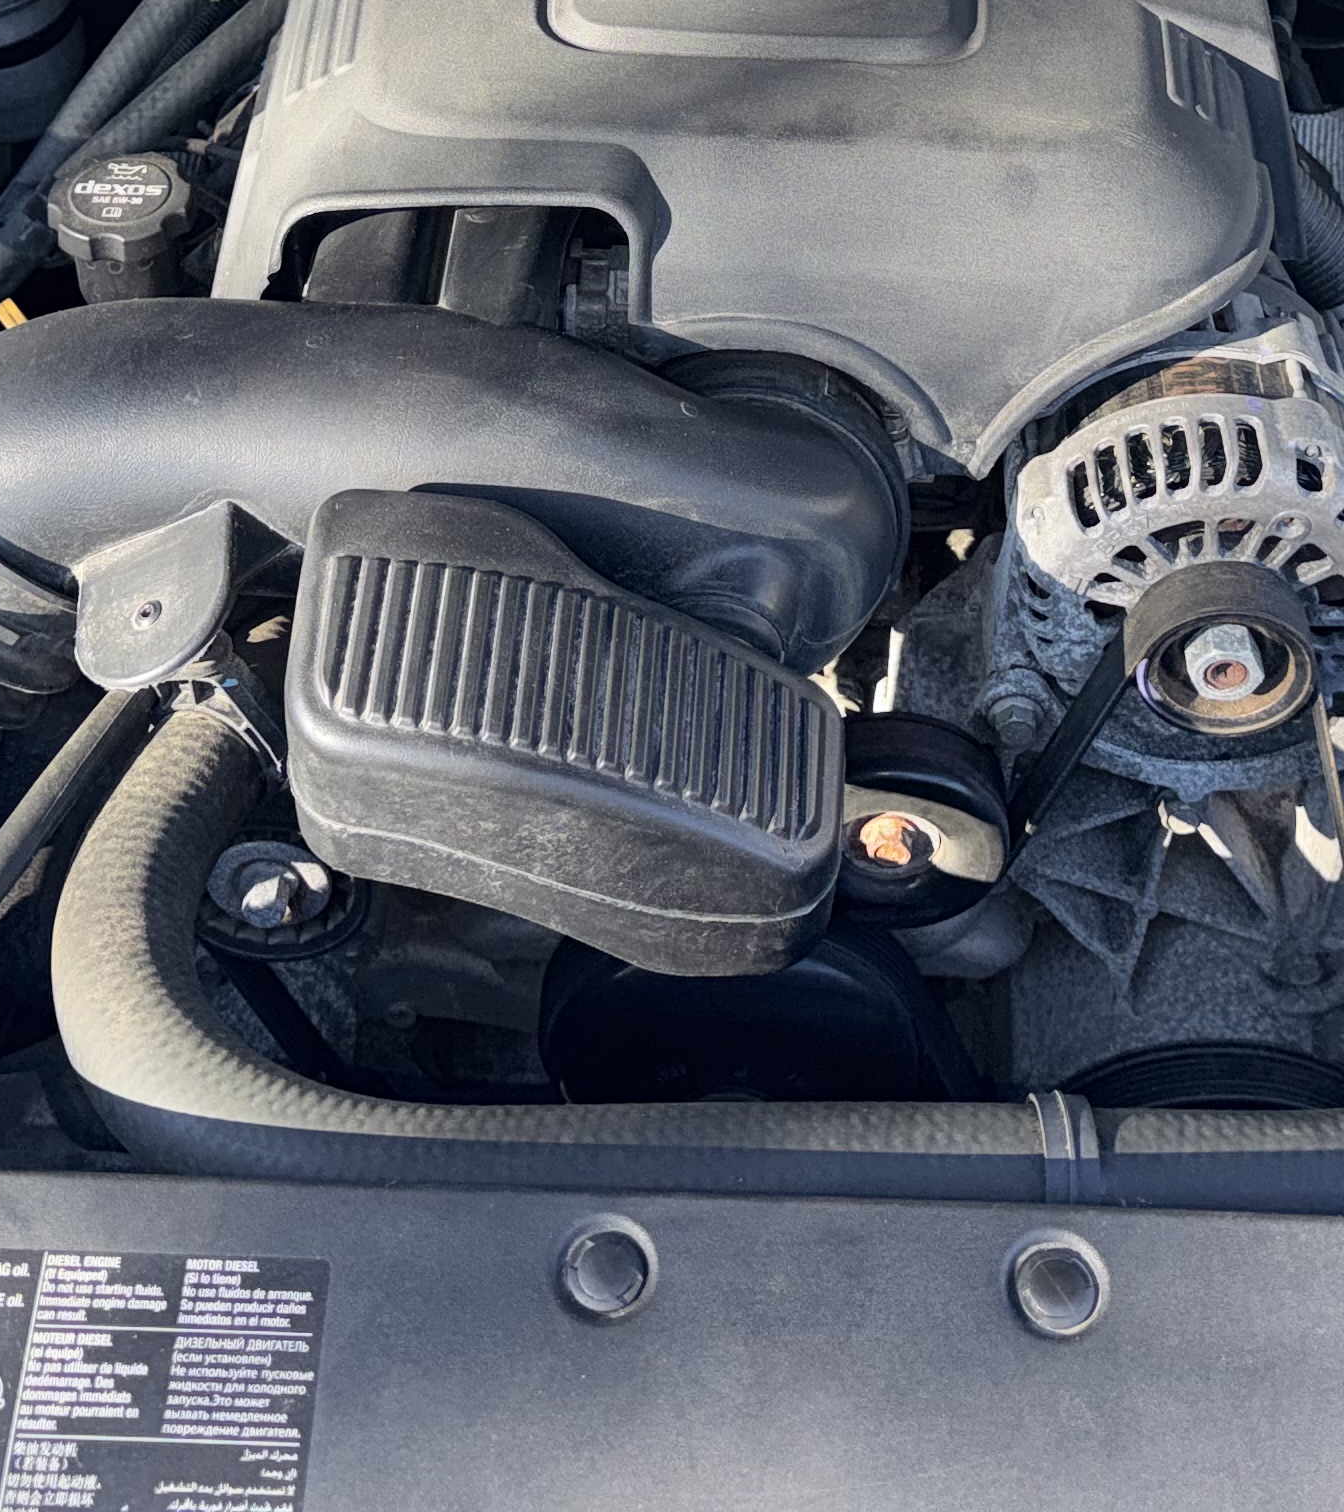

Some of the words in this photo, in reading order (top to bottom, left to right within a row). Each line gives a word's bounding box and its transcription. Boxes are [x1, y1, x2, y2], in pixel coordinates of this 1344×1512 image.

[74, 179, 168, 196] dexos
[92, 196, 111, 204] SAE
[112, 196, 143, 205] 5W-30
[47, 1254, 81, 1267] DIESEL
[83, 1255, 122, 1268] ENGINE
[185, 1259, 223, 1270] MOTOR
[224, 1260, 260, 1272] DIESEL
[12, 1263, 31, 1277] oil.
[57, 1269, 108, 1283] Equipped)
[184, 1272, 199, 1285] (Si
[200, 1273, 210, 1284] lo
[211, 1274, 241, 1286] tiene)
[42, 1281, 56, 1293] Do
[56, 1282, 74, 1294] not
[76, 1284, 93, 1294] use
[95, 1283, 133, 1298] starting
[135, 1284, 164, 1297] fluids.
[182, 1285, 196, 1297] No
[197, 1287, 216, 1298] use
[218, 1287, 251, 1299] fluidos
[252, 1288, 266, 1299] de
[267, 1290, 314, 1303] arranque.
[6, 1293, 25, 1307] oil.
[40, 1295, 91, 1308] Immediate
[92, 1297, 126, 1310] engine
[127, 1298, 168, 1312] damage
[180, 1298, 194, 1311] Se
[194, 1300, 232, 1313] pueden
[232, 1301, 275, 1314] producir
[276, 1302, 307, 1315] daños
[36, 1310, 55, 1320] can
[56, 1310, 87, 1322] result.
[233, 1316, 247, 1326] en
[248, 1315, 259, 1327] el
[260, 1316, 291, 1328] motor.
[32, 1331, 76, 1344] MOTEUR
[76, 1333, 113, 1347] DIESEL
[173, 1336, 245, 1350] ДИЗЕЛЬНЫЙ
[246, 1339, 310, 1353] ДВИГАТЕЛЬ
[172, 1350, 202, 1363] (если
[204, 1353, 272, 1367] установлен)
[27, 1359, 42, 1373] Ne
[42, 1362, 62, 1375] pas
[63, 1361, 99, 1374] utiliser
[99, 1362, 113, 1374] de
[113, 1362, 149, 1377] liquide
[169, 1364, 187, 1376] Не
[188, 1367, 258, 1380] используйте
[260, 1369, 315, 1382] пусковые
[22, 1388, 77, 1404] dommages
[167, 1380, 222, 1391] жидкости
[223, 1382, 245, 1393] для
[246, 1383, 307, 1396] холодного
[234, 1397, 272, 1408] может
[19, 1404, 34, 1416] au
[34, 1403, 71, 1417] moteur
[70, 1404, 125, 1419] pourraient
[125, 1407, 140, 1419] en
[163, 1409, 210, 1420] вызвать
[211, 1411, 288, 1423] немедленное
[160, 1423, 240, 1437] повреждение
[241, 1426, 301, 1438] двигателя.
